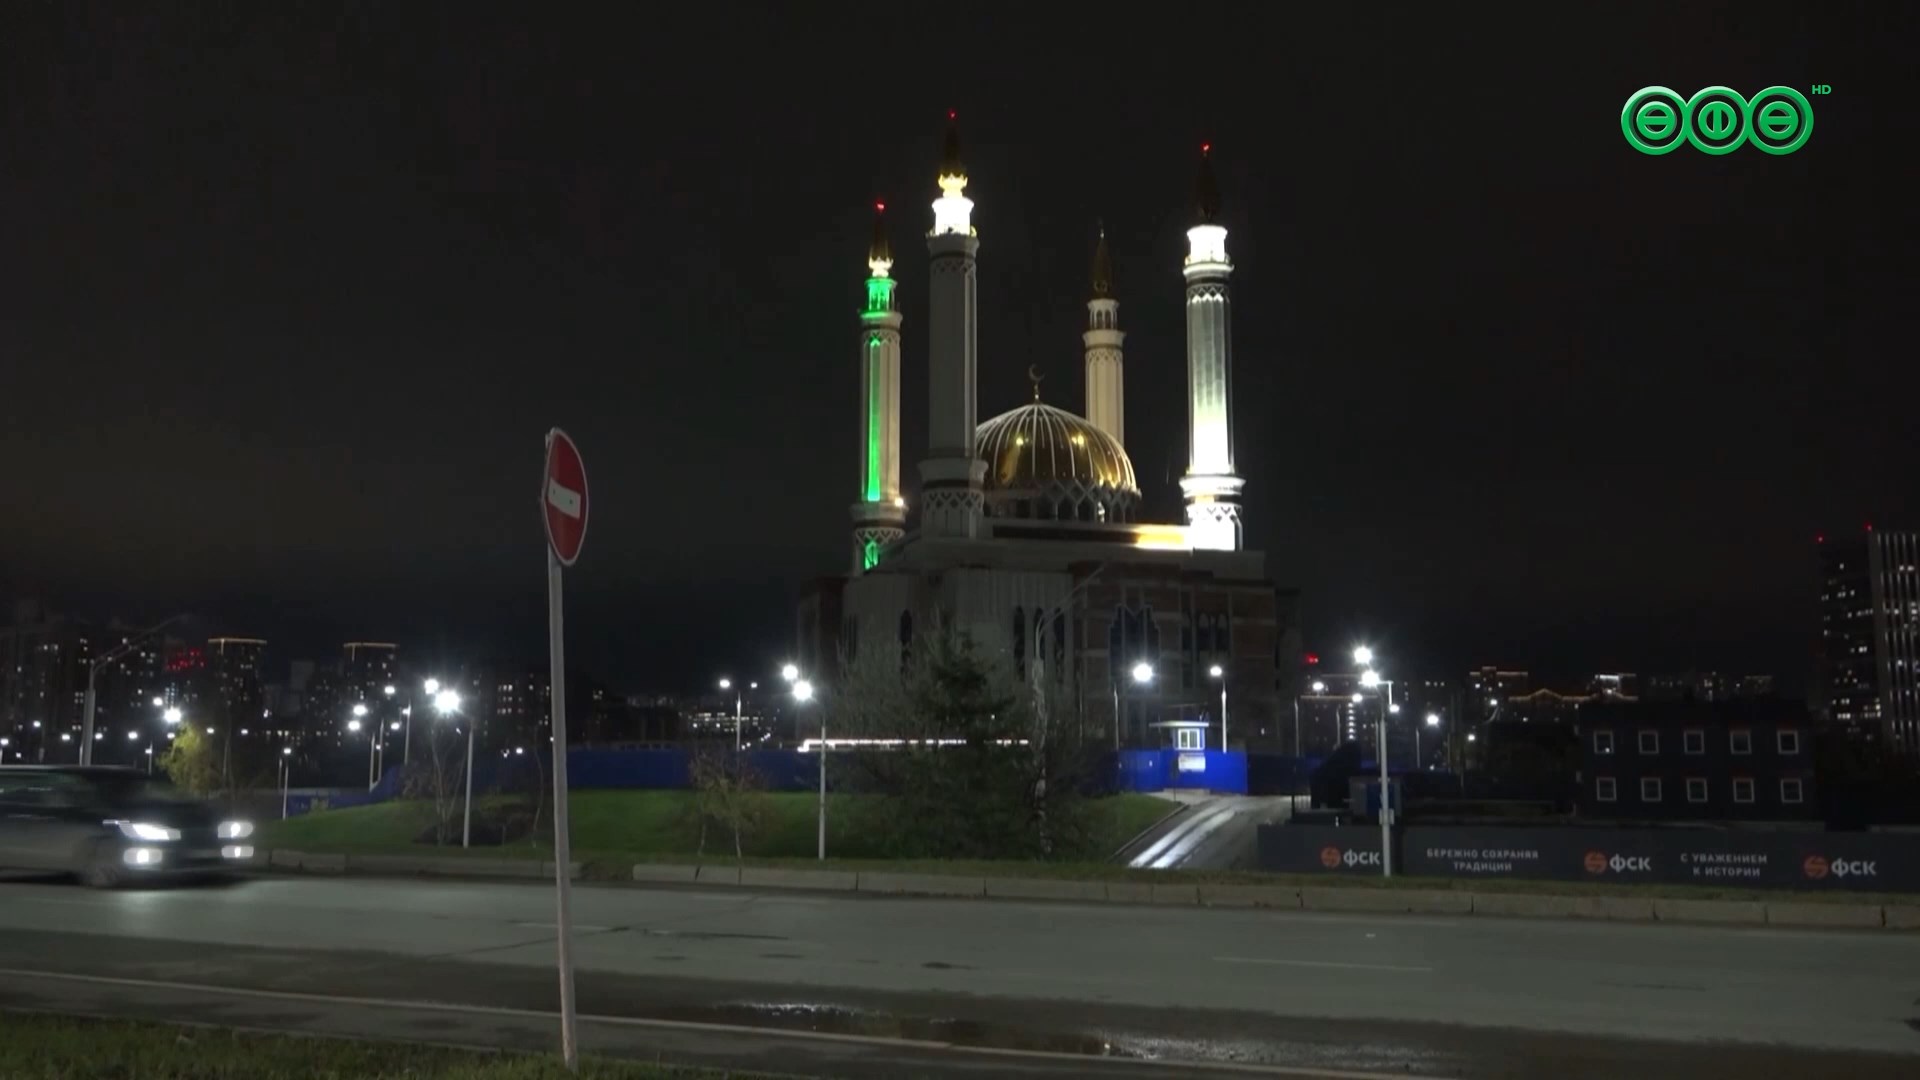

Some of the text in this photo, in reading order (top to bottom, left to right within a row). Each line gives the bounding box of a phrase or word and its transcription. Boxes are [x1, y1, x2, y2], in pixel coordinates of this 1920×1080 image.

[1343, 848, 1381, 868] ФСК
[1426, 848, 1539, 860] БЕРЕЖНО СОХРАНЯЯ
[1680, 853, 1768, 864] С УВАЖЕНИЕМ
[1453, 861, 1512, 872] ТРАДИЦИИ
[1609, 853, 1652, 873] ФСК
[1831, 857, 1877, 878] ФСК
[1693, 866, 1761, 877] К ИСТОРИИ
